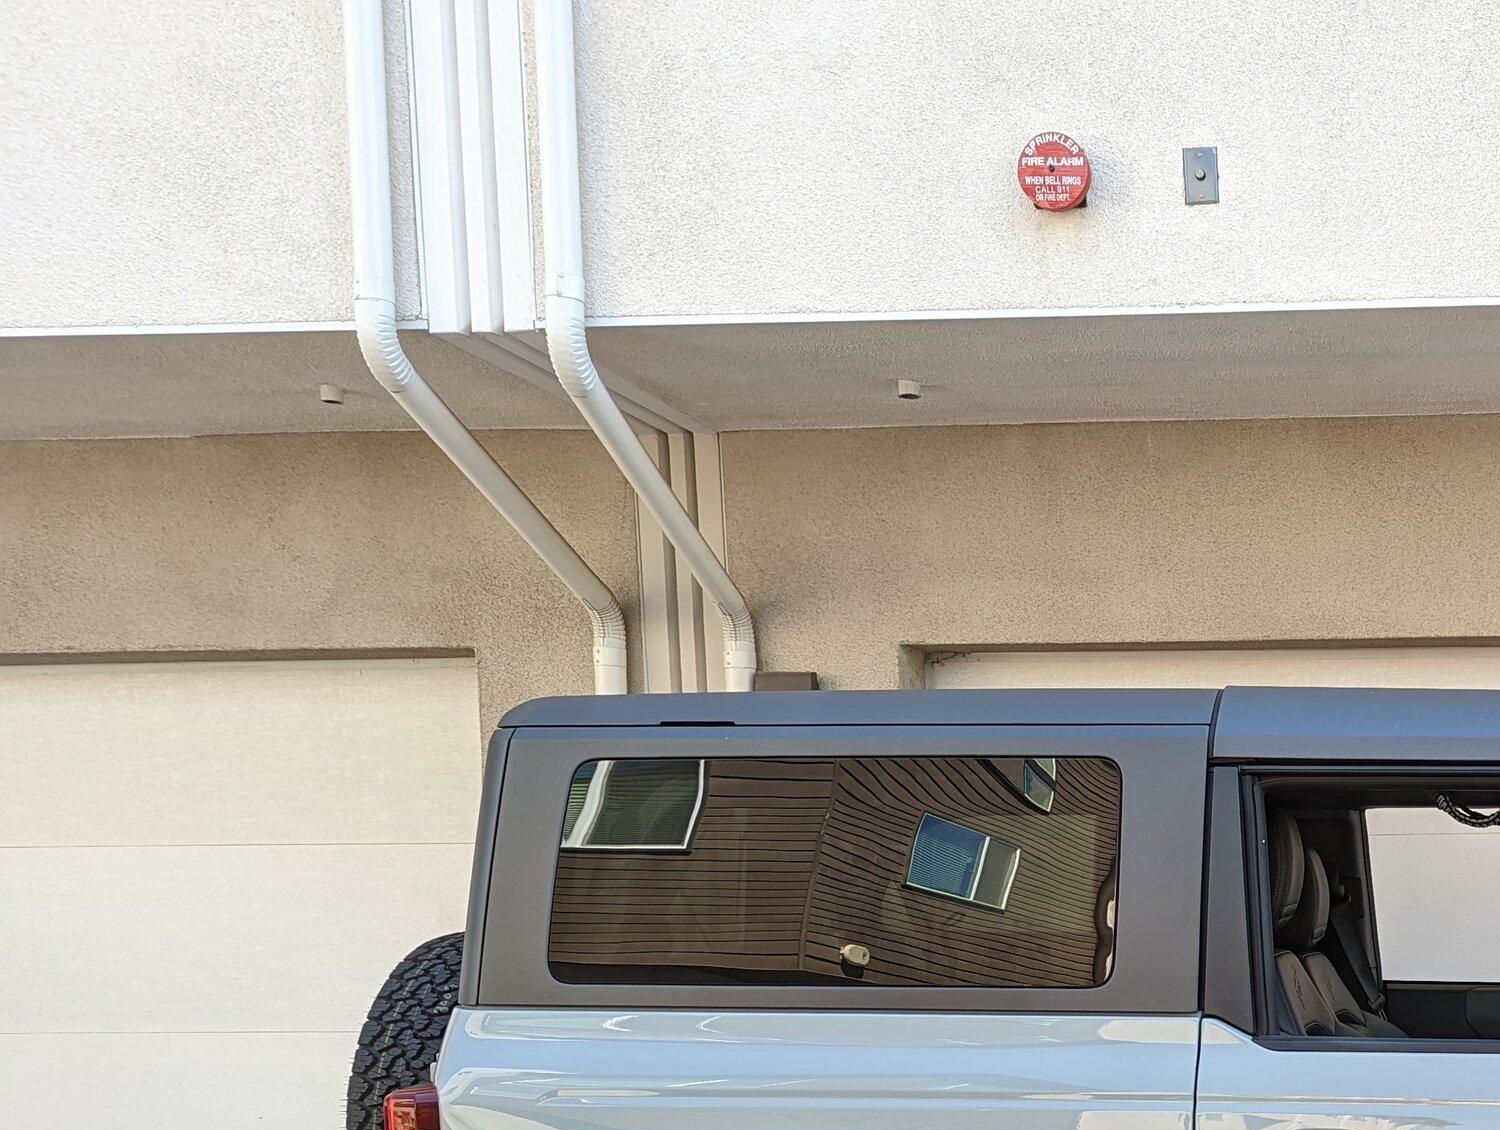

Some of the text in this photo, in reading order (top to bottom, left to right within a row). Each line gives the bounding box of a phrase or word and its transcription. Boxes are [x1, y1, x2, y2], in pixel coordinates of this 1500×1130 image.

[1024, 133, 1080, 156] SPRINKLER
[1021, 156, 1084, 166] FIRE ALARM
[1024, 176, 1081, 185] WHEN BELL RINGS
[1035, 186, 1070, 194] CALL 911
